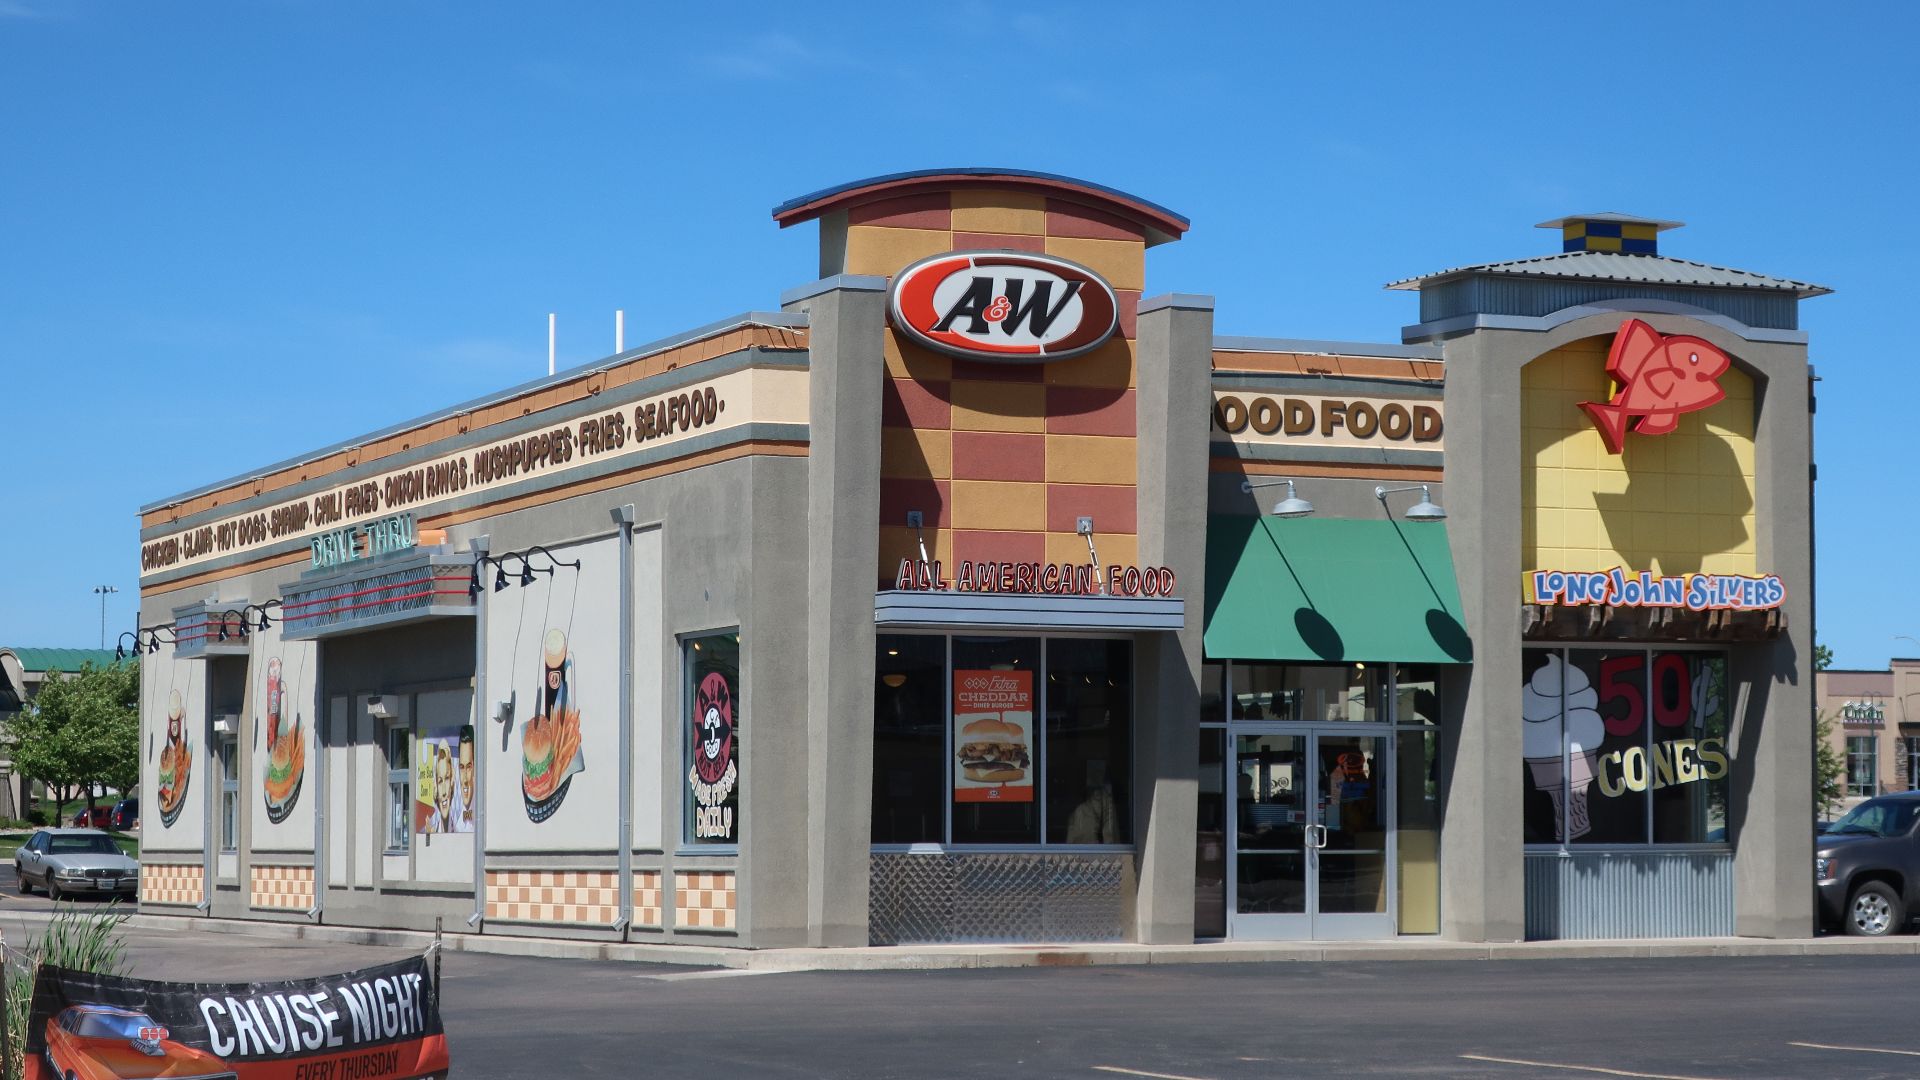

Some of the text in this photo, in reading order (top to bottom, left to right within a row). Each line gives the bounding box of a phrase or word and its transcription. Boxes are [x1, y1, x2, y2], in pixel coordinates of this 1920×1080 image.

[931, 276, 1086, 338] A&W
[1210, 395, 1443, 443] OOD FOOD
[141, 537, 179, 572] CHICKEN
[184, 526, 213, 560] CLAMS
[217, 520, 237, 553] HOT
[238, 513, 267, 546] DOGS
[270, 500, 309, 538] SHRIMP
[314, 491, 342, 526] CHILI
[345, 481, 378, 518] FRIES
[385, 469, 424, 508] ONION
[426, 457, 468, 498] RINGS
[474, 427, 572, 485] HUSHPUPPIES
[579, 412, 625, 457] FRIES
[311, 512, 413, 568] DRIVE THRU
[898, 558, 1177, 597] ALL AMERICAN FOOD
[958, 692, 1028, 702] CHEDDAR
[689, 758, 737, 807] MADE FRESH
[1598, 737, 1728, 797] CONES
[697, 806, 732, 838] DAILY
[199, 972, 423, 1057] CRUISE NIGHT
[295, 1051, 399, 1080] EVERY THURSDAY
